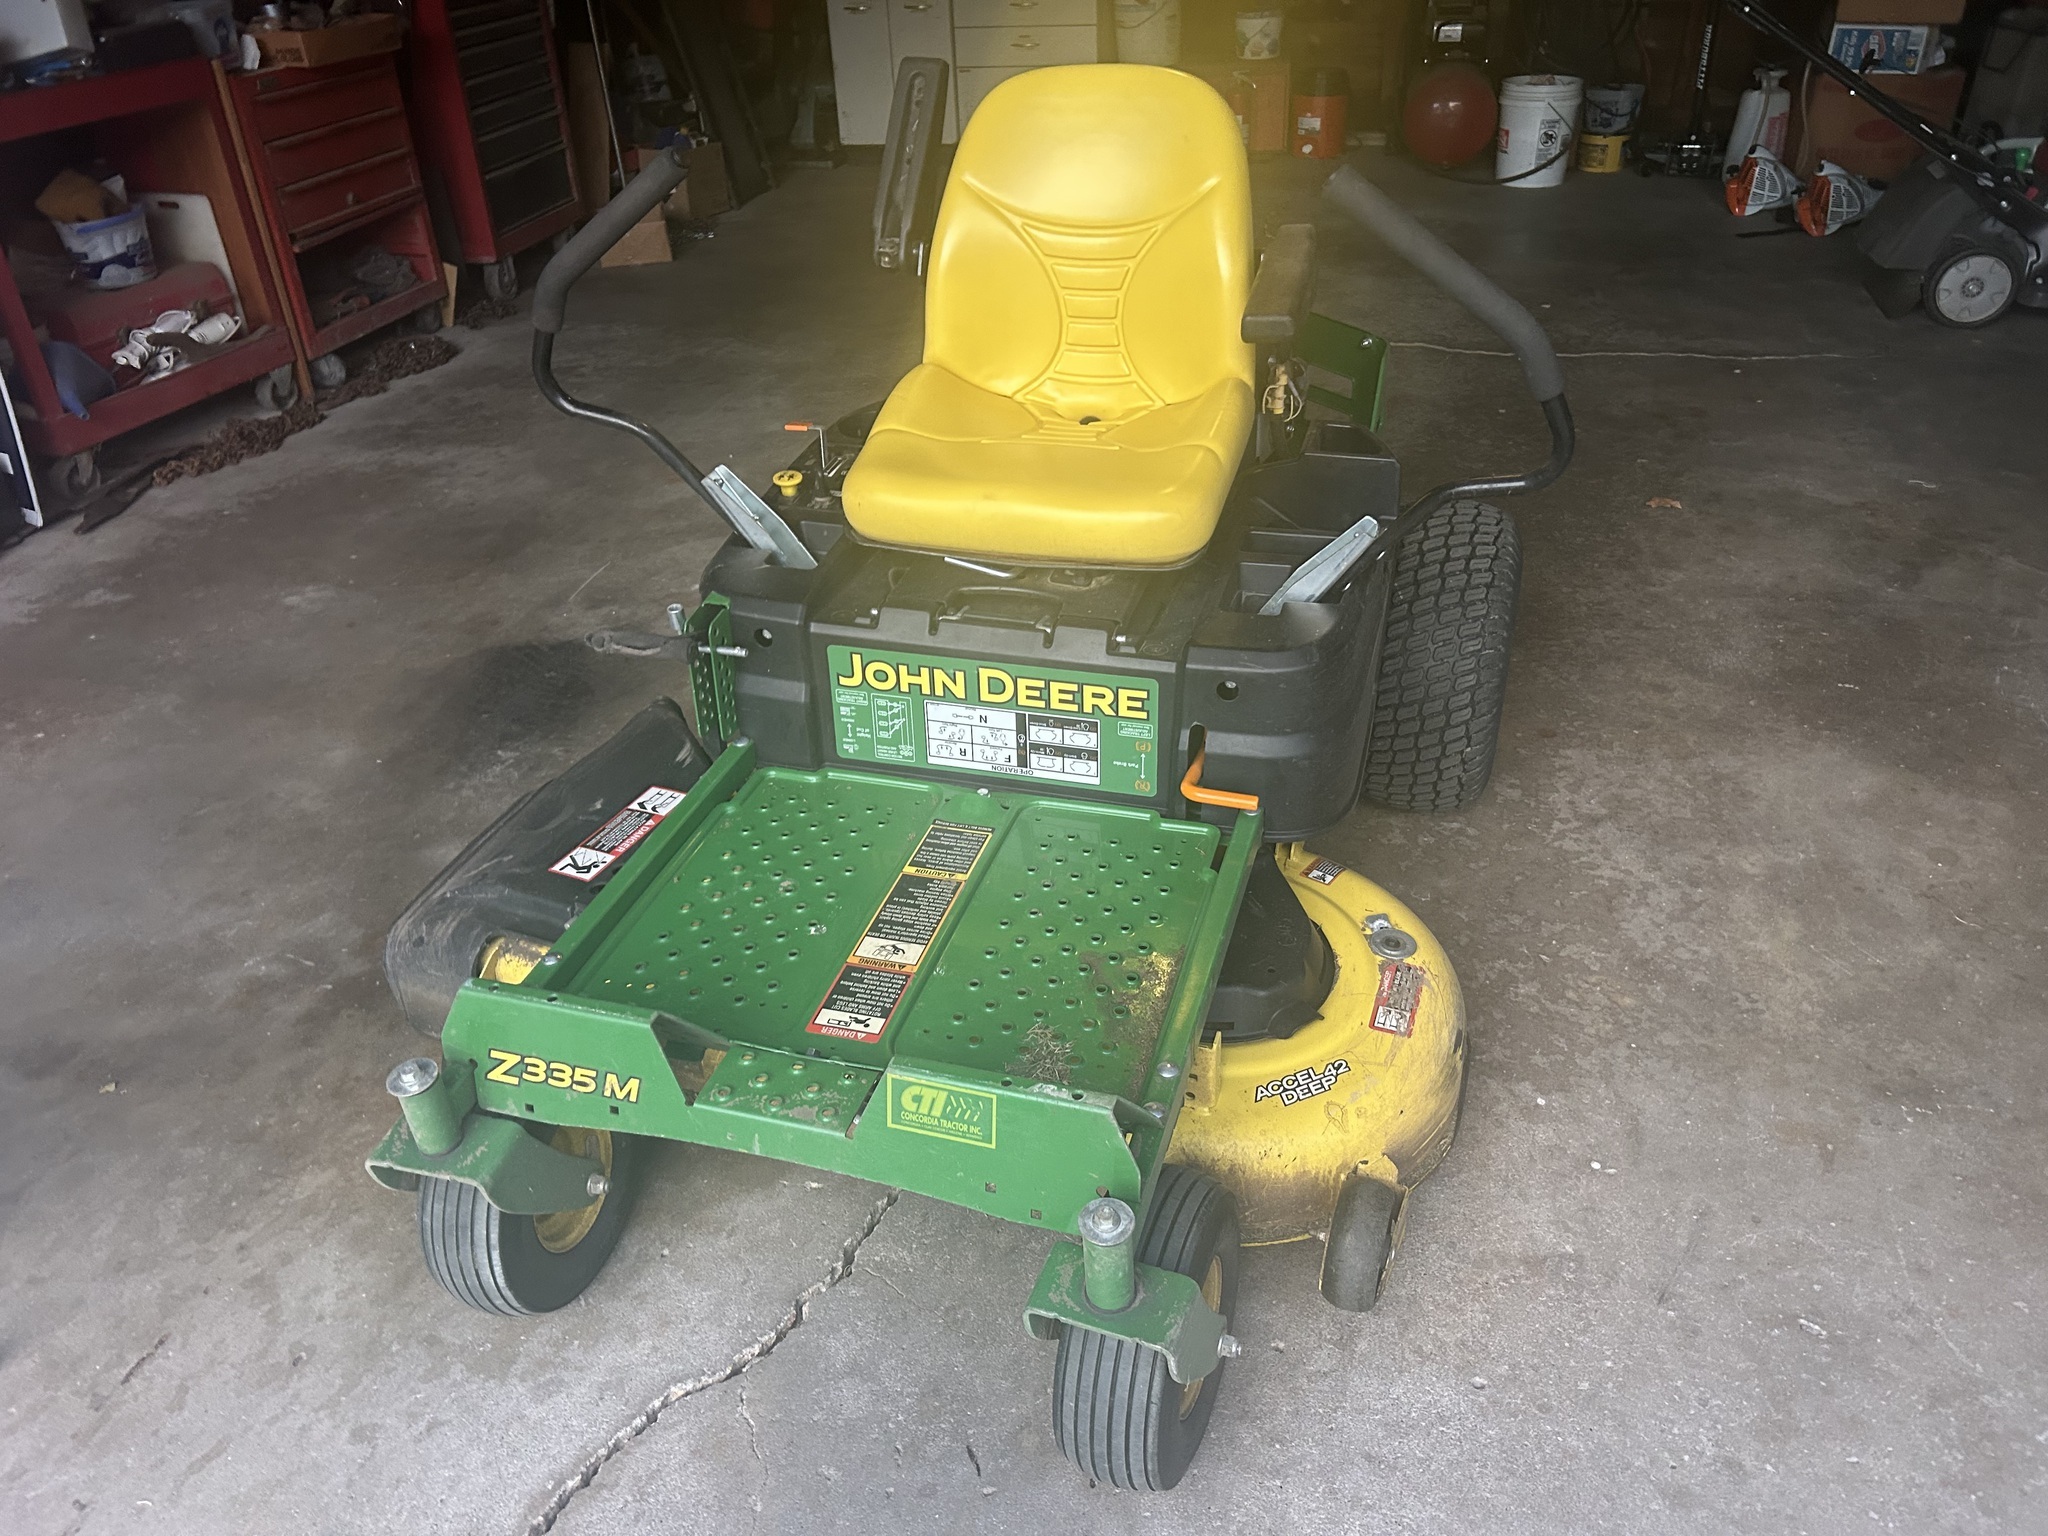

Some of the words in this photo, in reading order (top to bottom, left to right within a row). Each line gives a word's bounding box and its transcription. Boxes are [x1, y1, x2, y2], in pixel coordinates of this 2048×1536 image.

[837, 652, 966, 700] JOHN
[977, 666, 1149, 720] DEERE
[979, 715, 987, 724] N
[959, 748, 967, 756] R
[1004, 754, 1011, 762] F
[991, 765, 1034, 776] OPERATION
[614, 824, 651, 853] DANGER
[914, 868, 948, 877] CAUTION
[858, 958, 896, 968] WARNING
[821, 1026, 857, 1038] DANGER
[486, 1048, 598, 1094] Z335
[602, 1072, 641, 1104] M
[1280, 1076, 1337, 1106] DEEP
[900, 1085, 948, 1118] CTI
[901, 1111, 939, 1126] CONCORDIA
[940, 1119, 968, 1131] TRACTOR
[969, 1126, 983, 1135] INC.
